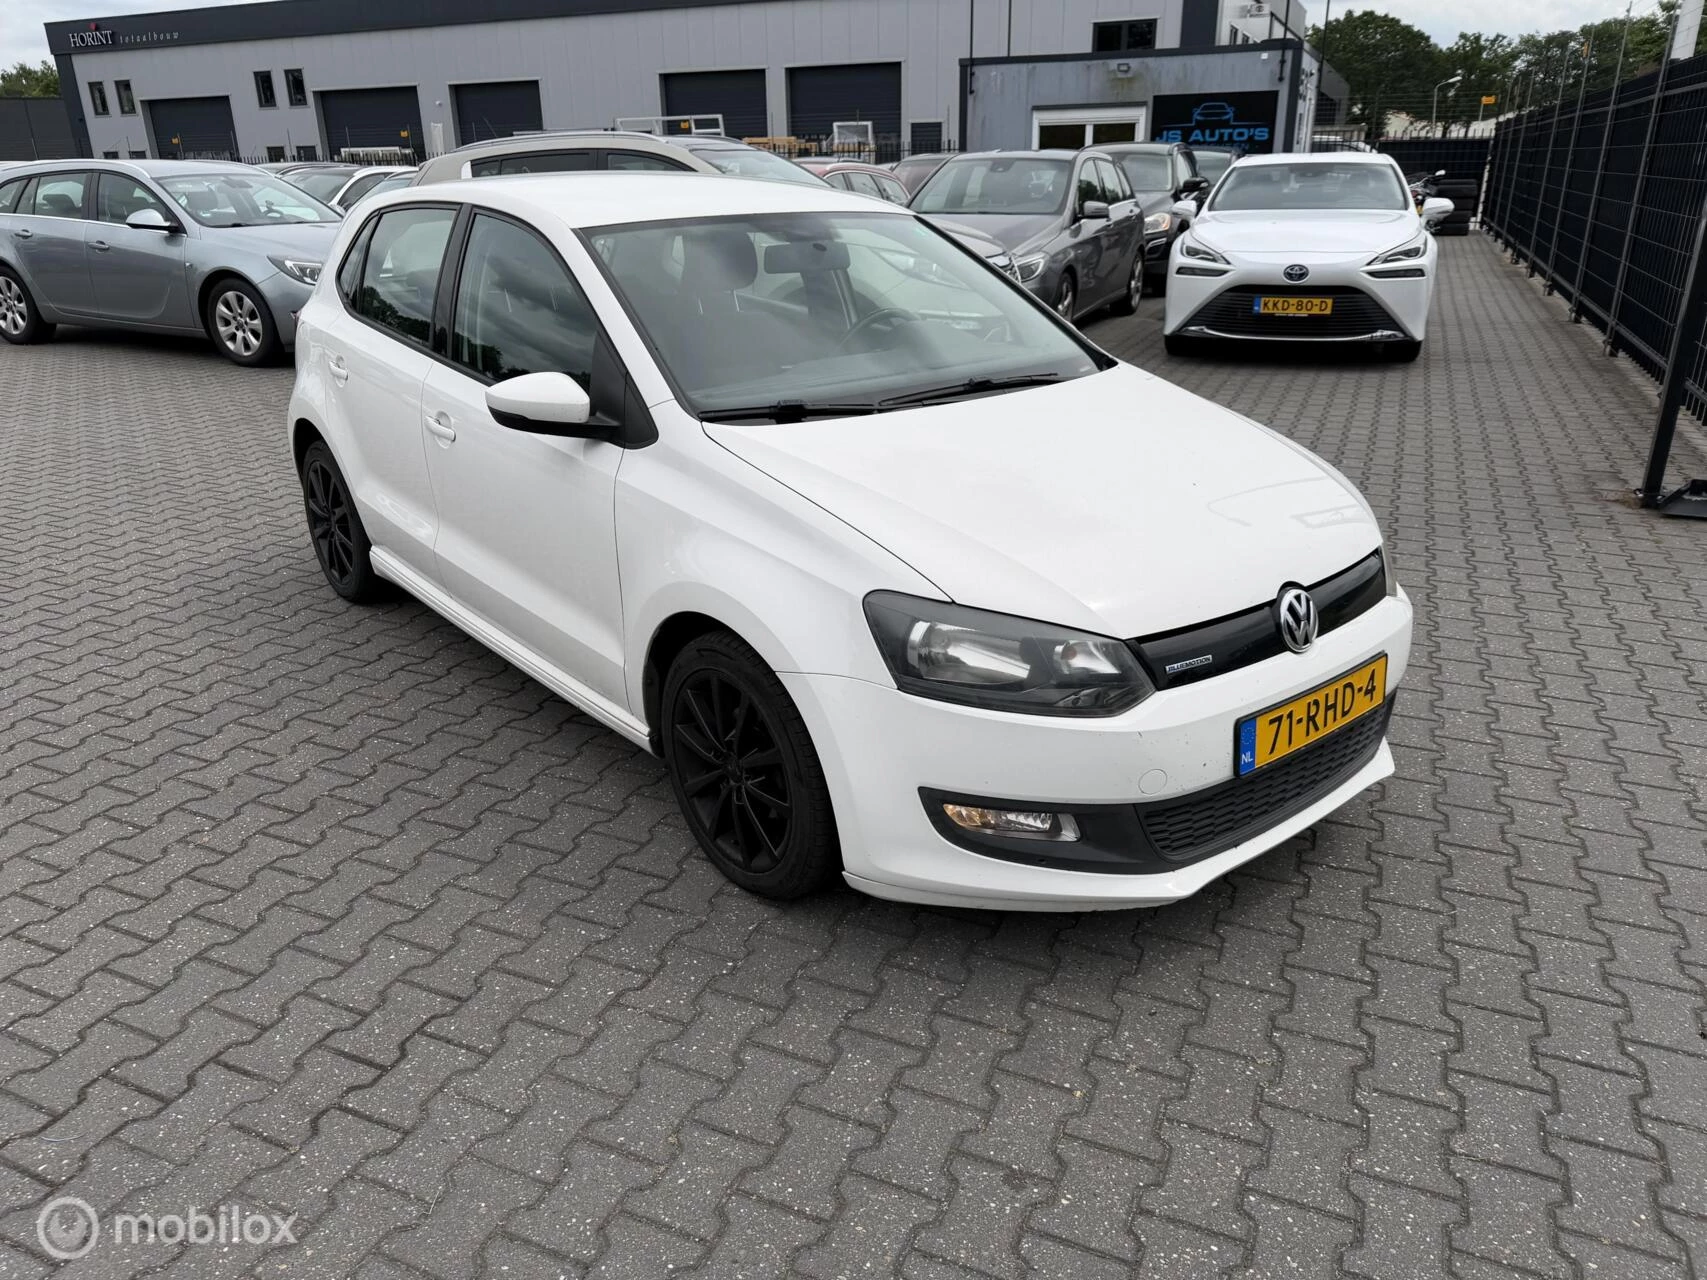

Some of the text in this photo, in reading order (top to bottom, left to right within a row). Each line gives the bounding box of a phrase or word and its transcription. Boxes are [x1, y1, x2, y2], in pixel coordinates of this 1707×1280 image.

[69, 30, 179, 47] HORINT totaalbouw
[1155, 127, 1269, 143] JS AUTO'S
[1262, 299, 1328, 312] KKD-80-D
[1167, 656, 1212, 673] BLUEMOTION
[1268, 668, 1376, 755] 71-RHD-4
[1241, 752, 1253, 765] NL
